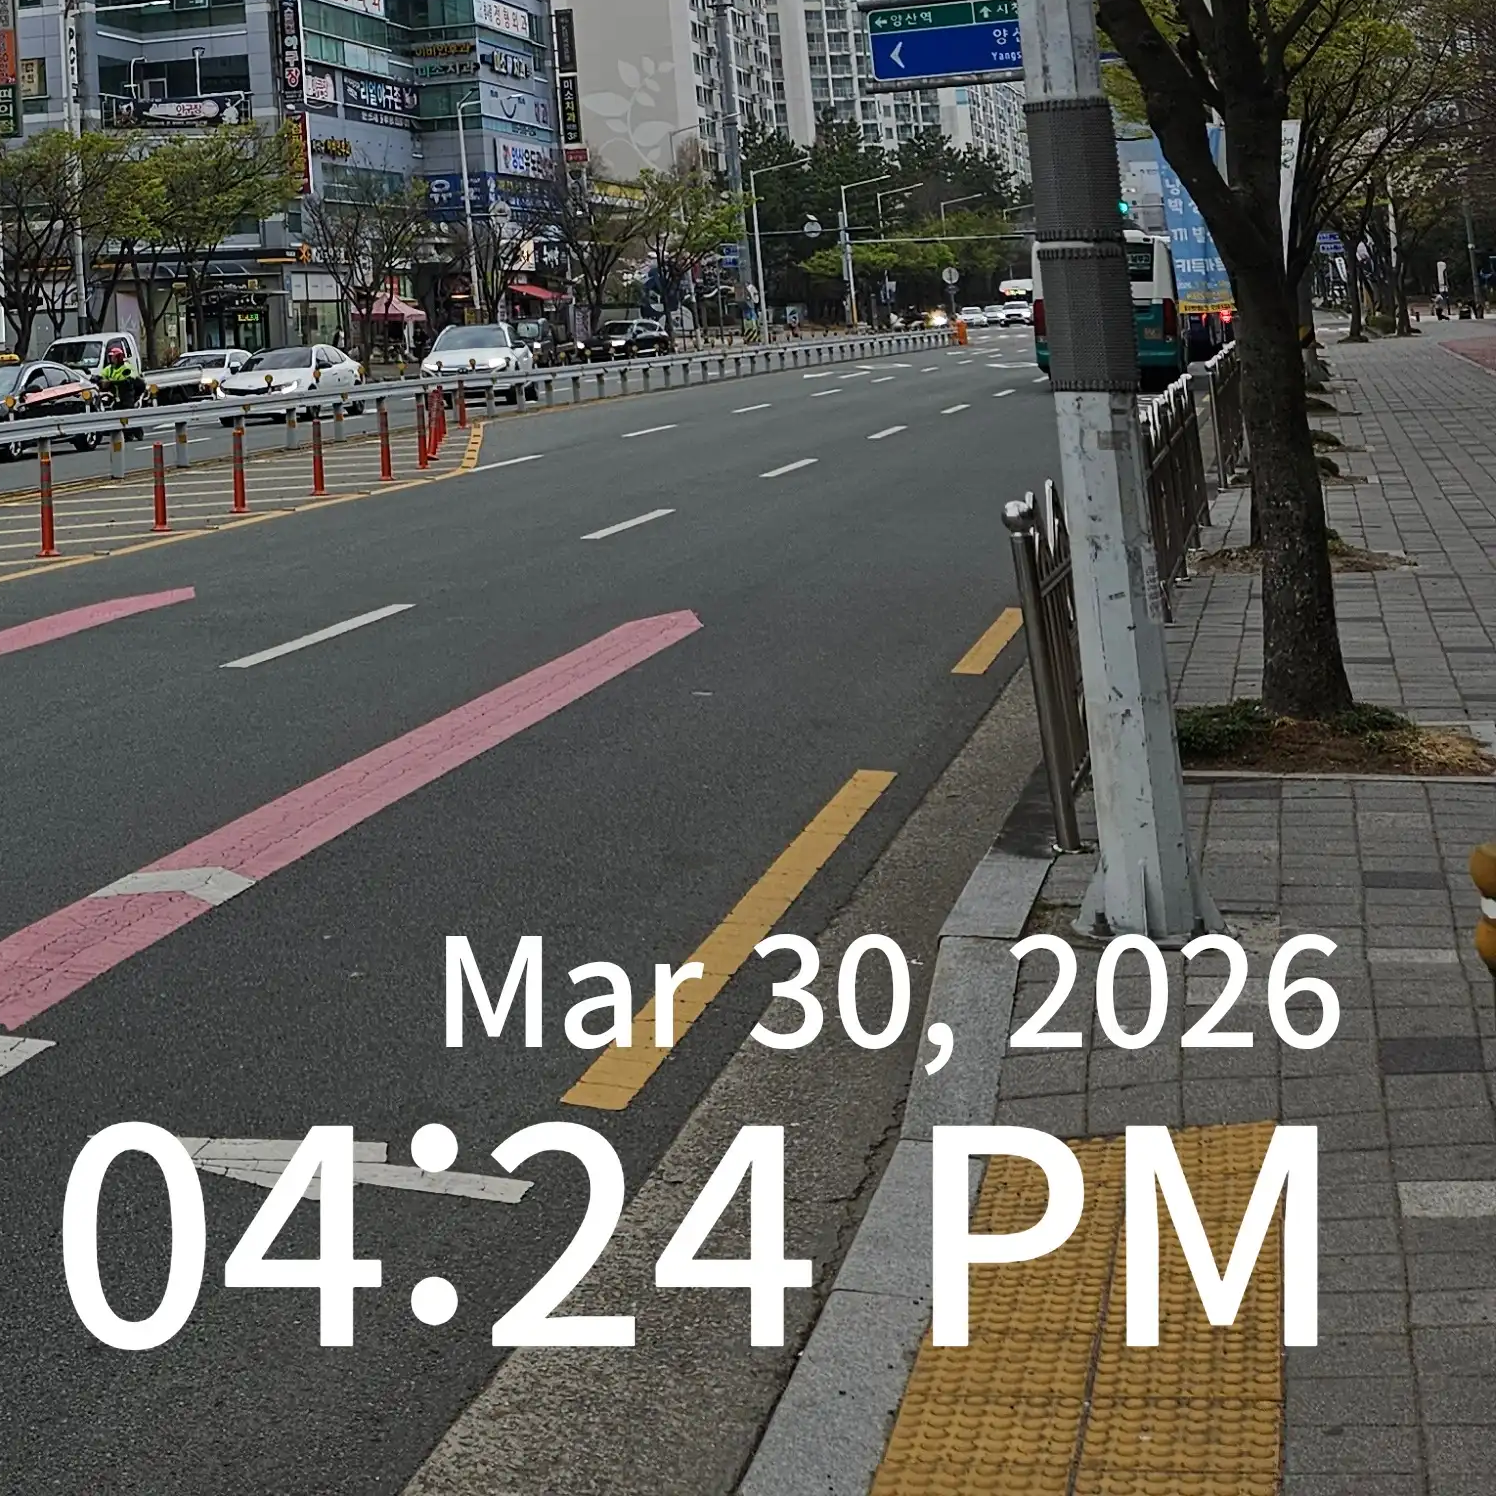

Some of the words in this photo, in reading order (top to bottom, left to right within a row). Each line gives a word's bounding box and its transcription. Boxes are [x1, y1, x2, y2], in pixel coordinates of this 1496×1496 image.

[890, 11, 933, 27] 양산역
[992, 51, 1022, 61] Yangs
[564, 78, 576, 123] 미소치과
